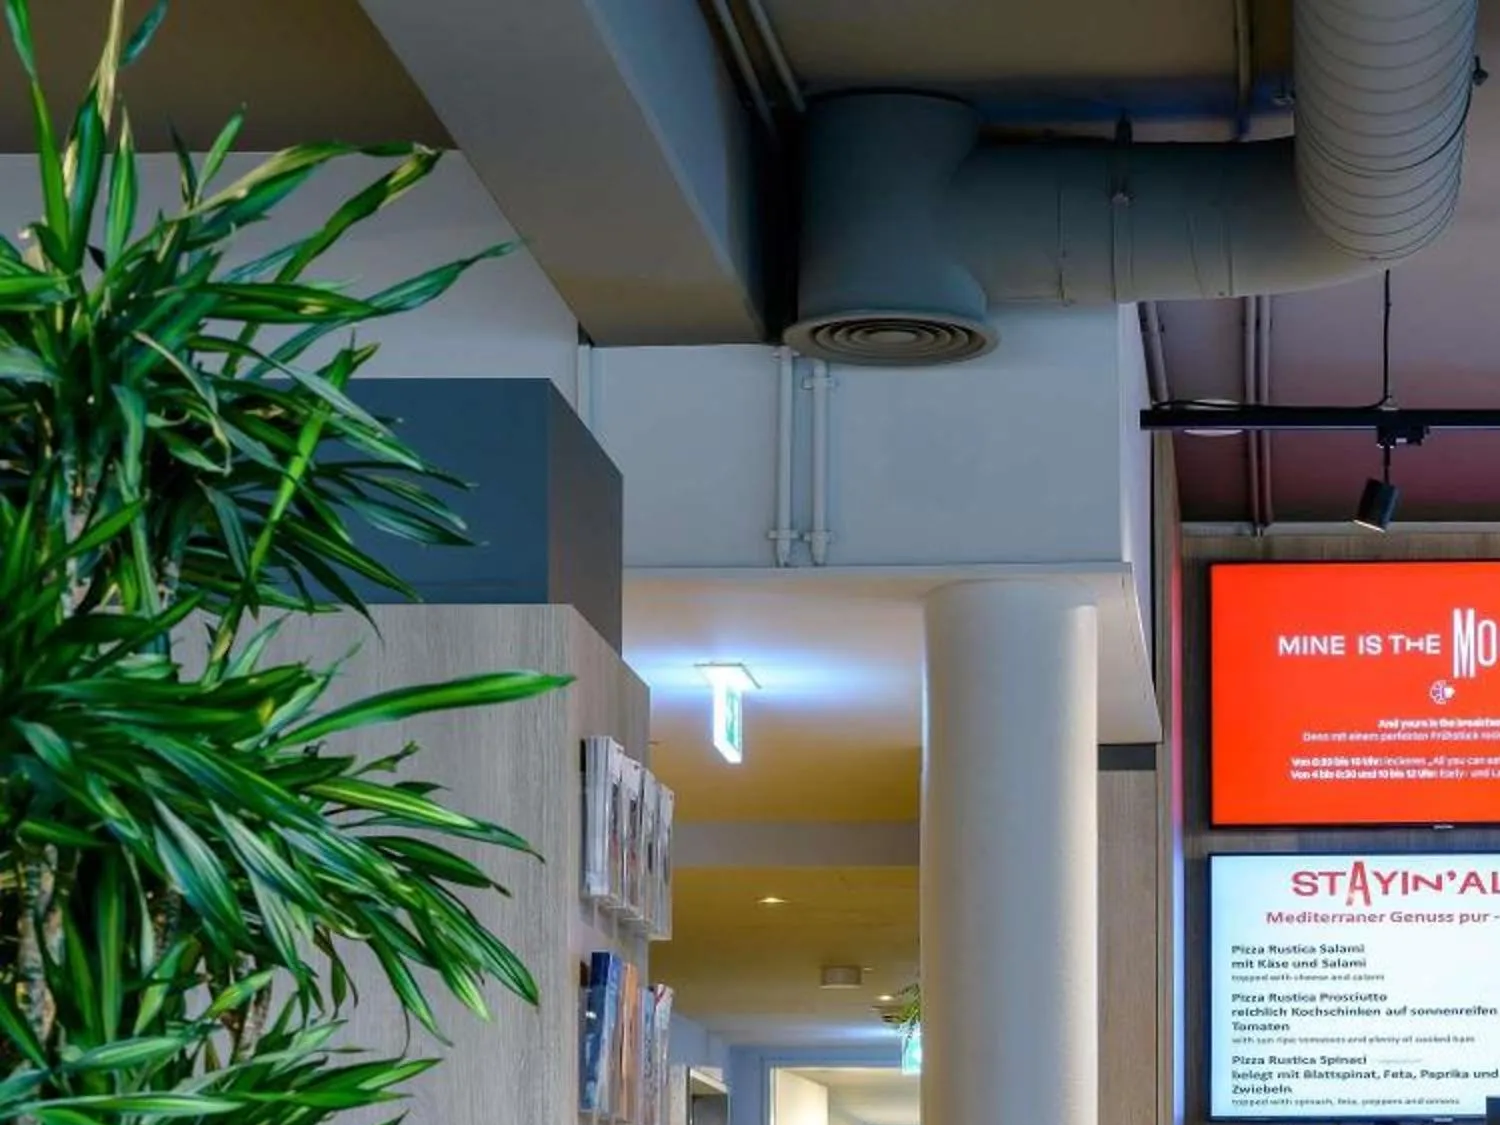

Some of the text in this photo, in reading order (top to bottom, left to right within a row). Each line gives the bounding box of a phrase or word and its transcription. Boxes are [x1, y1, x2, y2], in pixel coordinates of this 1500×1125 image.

[1278, 633, 1346, 656] MINE
[1358, 633, 1383, 656] IS
[1388, 633, 1441, 656] THE
[1266, 909, 1386, 924] Mediterraner
[1390, 909, 1455, 924] Genuss
[1459, 911, 1489, 927] pur
[1231, 944, 1365, 954] Pizza Rustica Salami
[1231, 958, 1367, 969] mit Käse und Salami
[1231, 993, 1388, 1003] Pizza Rustica Prosciutto
[1231, 1006, 1498, 1017] reichlich Kochschinken auf sonnenreifen
[1232, 1021, 1290, 1031] Tomaten
[1231, 1055, 1367, 1067] Pizza Rustica Spinaci
[1277, 1069, 1299, 1079] mit
[1303, 1069, 1381, 1080] Blattspinat,
[1383, 1069, 1417, 1080] Feta,
[1420, 1069, 1469, 1080] Paprika
[1473, 1068, 1499, 1079] und
[1231, 1084, 1293, 1095] Zwiebeln
